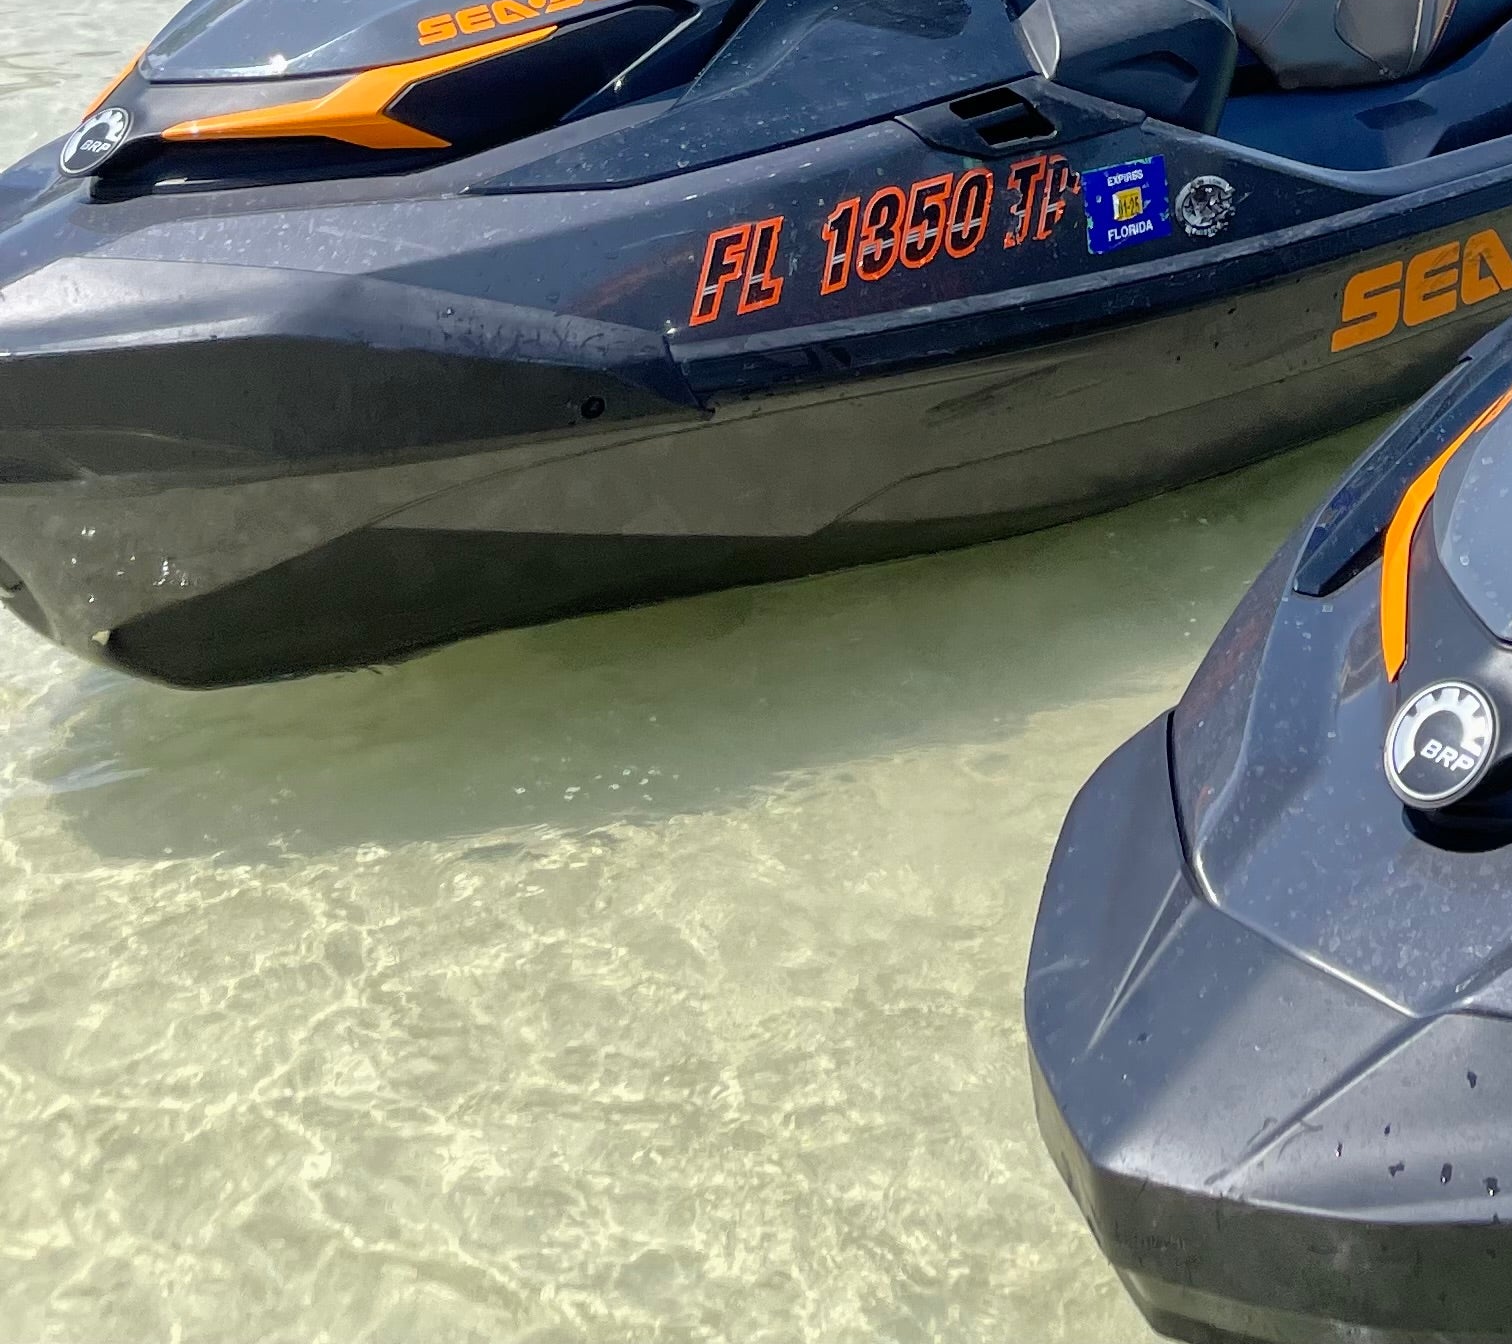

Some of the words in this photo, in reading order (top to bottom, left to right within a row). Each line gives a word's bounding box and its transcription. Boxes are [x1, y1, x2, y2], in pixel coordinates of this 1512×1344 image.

[80, 139, 111, 153] BRP
[1107, 169, 1144, 187] EXPIRES
[1107, 219, 1154, 242] FLORIDA
[689, 215, 785, 328] FL
[819, 167, 995, 297] 1350
[1420, 738, 1475, 772] BRP
